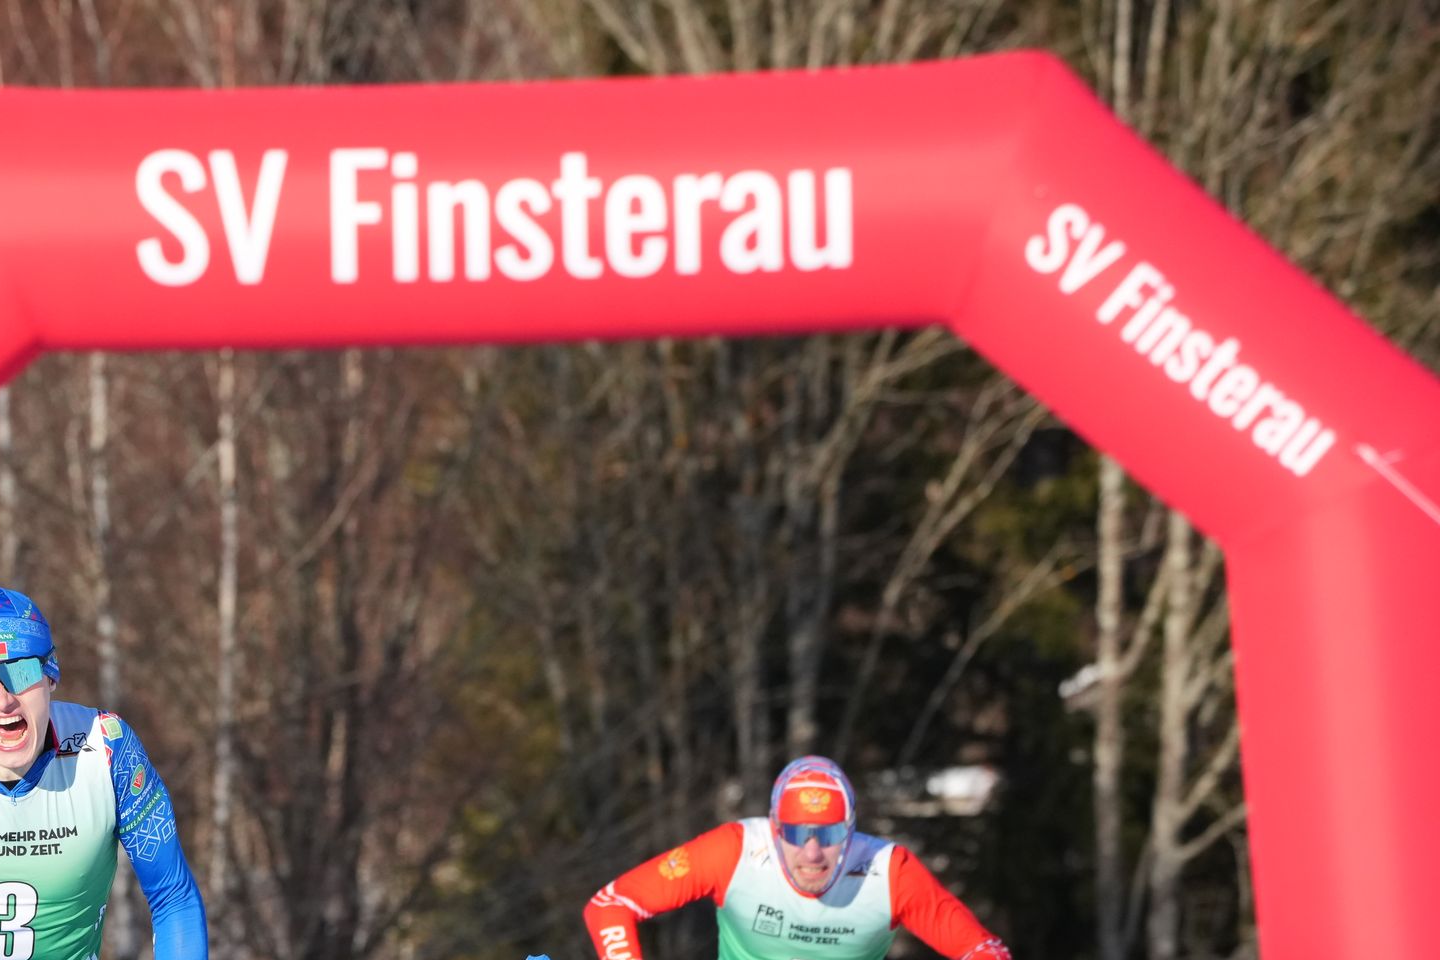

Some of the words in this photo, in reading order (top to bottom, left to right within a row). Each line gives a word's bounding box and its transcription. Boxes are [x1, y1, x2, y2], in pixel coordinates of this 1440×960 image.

[135, 147, 288, 287] SV
[329, 146, 854, 284] Finsterau
[1024, 203, 1127, 295] SV
[1095, 261, 1337, 478] Finsterau
[39, 825, 78, 841] RAUM
[30, 843, 62, 856] ZEIT.
[758, 904, 784, 921] FRG
[790, 923, 821, 935] MEHR
[823, 926, 855, 935] RAUM
[788, 933, 813, 943] UND
